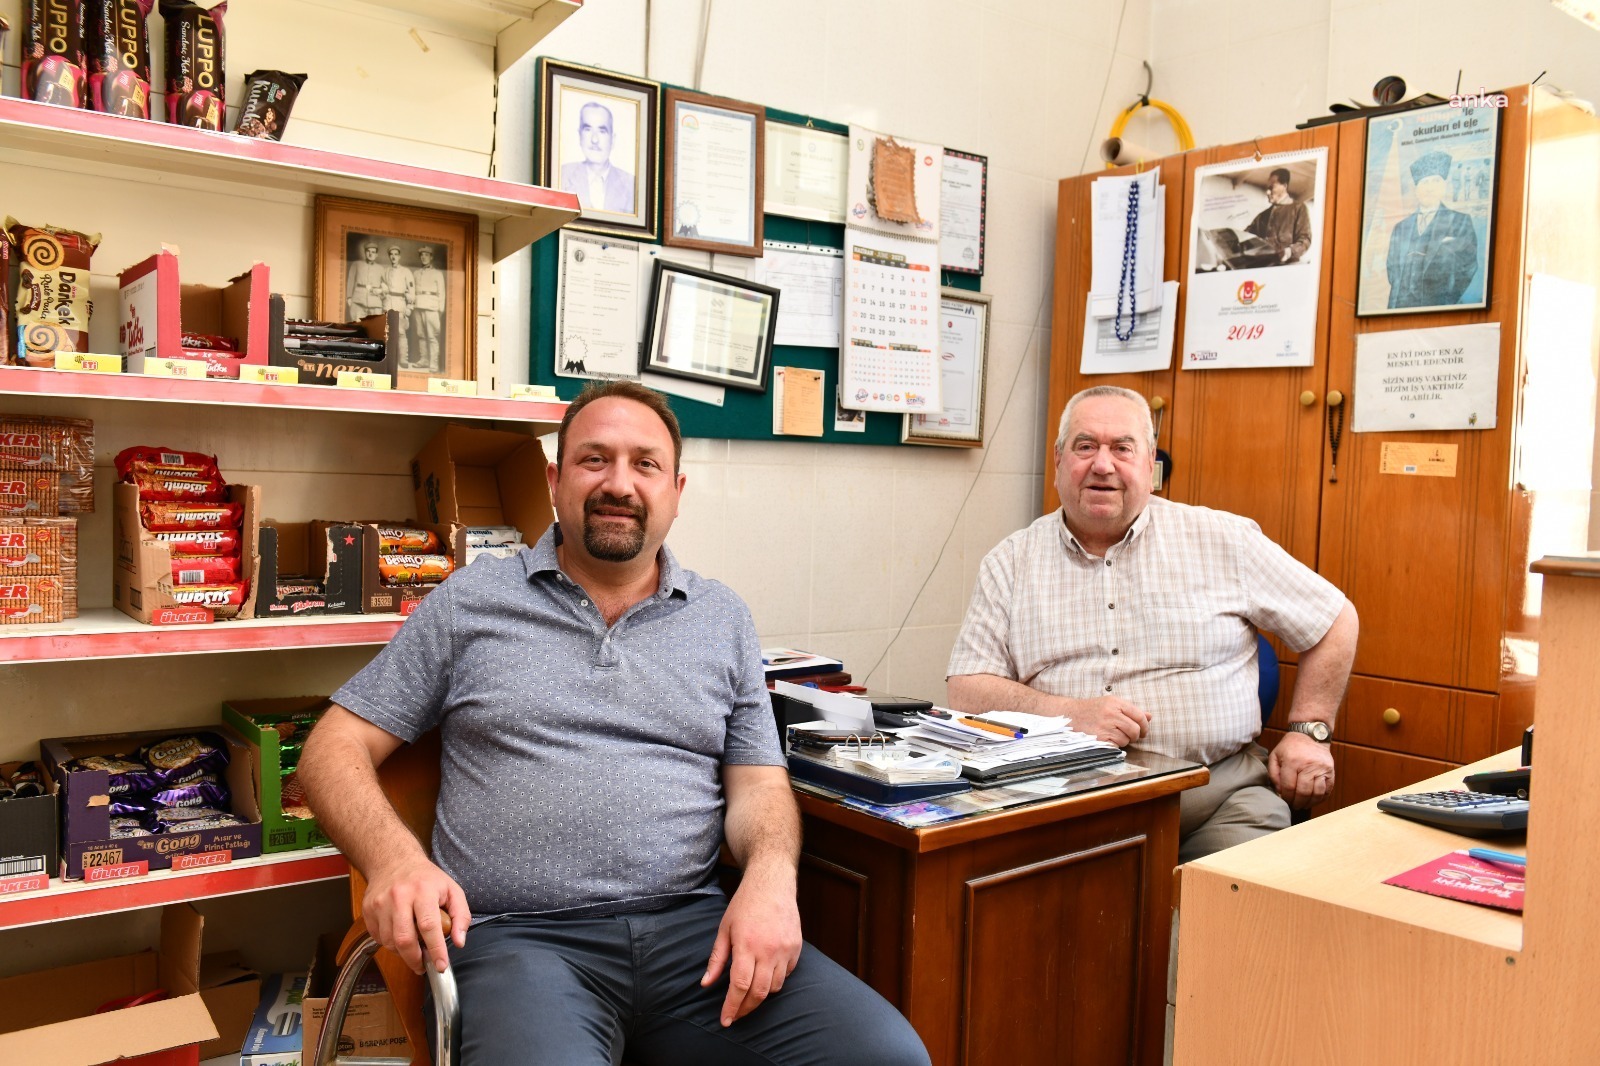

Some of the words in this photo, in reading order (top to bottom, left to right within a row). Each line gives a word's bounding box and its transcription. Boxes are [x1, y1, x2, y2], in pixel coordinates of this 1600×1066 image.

[50, 0, 67, 53] UPPO
[181, 21, 191, 55] Sandviç
[197, 14, 214, 88] LUPPO
[1413, 123, 1449, 137] okurları
[1452, 120, 1461, 128] el
[1463, 118, 1478, 129] ele
[54, 271, 76, 325] Dankek
[40, 297, 54, 320] Pasta
[1226, 324, 1265, 341] 2019
[1414, 350, 1437, 358] DOST
[1439, 348, 1451, 356] EN
[1453, 347, 1464, 355] AZ
[82, 361, 98, 370] ETi
[265, 373, 278, 381] ETi
[1424, 372, 1468, 382] VAKTİNİZ
[1420, 382, 1465, 391] VAKTİMİZ
[0, 433, 41, 449] KER
[173, 590, 232, 605] Susam
[161, 611, 207, 624] ÜLKER
[109, 785, 130, 794] ong
[176, 796, 203, 808] Gong
[156, 834, 201, 854] Gong
[90, 850, 122, 867] 22467
[181, 853, 227, 868] ÜLKER
[91, 865, 139, 881] ÜLKER
[0, 878, 40, 893] LKER
